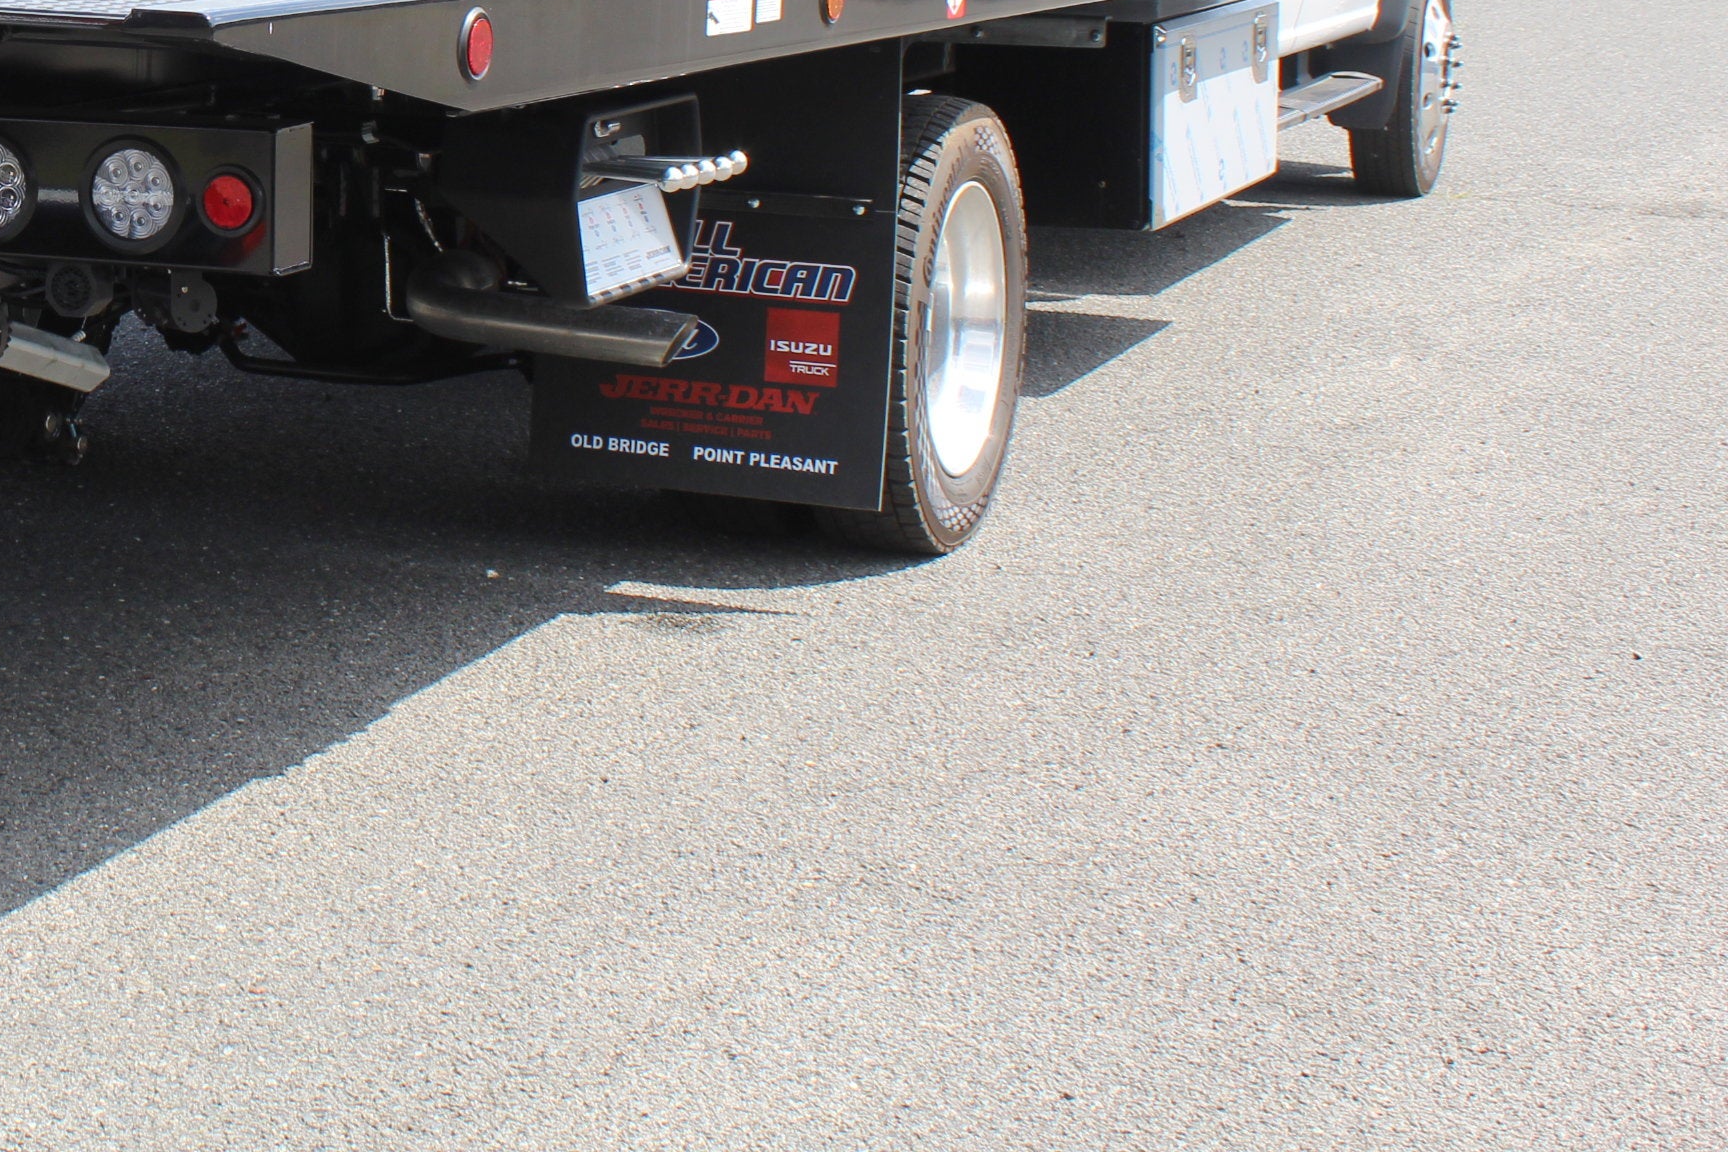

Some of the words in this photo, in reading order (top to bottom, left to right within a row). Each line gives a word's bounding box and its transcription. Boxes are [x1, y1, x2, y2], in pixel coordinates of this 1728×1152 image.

[692, 219, 742, 257] LL
[657, 255, 857, 302] ERICAN
[769, 339, 832, 356] ISUZU
[789, 363, 830, 376] TRUCK
[599, 374, 820, 415] JERR-DAN
[640, 417, 675, 431] SALES
[682, 421, 729, 437] SERVICE
[736, 427, 772, 441] PARTS
[716, 412, 764, 426] CARRIER
[571, 433, 603, 449] OLD
[608, 437, 669, 457] BRIDGE
[693, 446, 745, 465] POINT
[749, 452, 839, 475] PLEASANT
